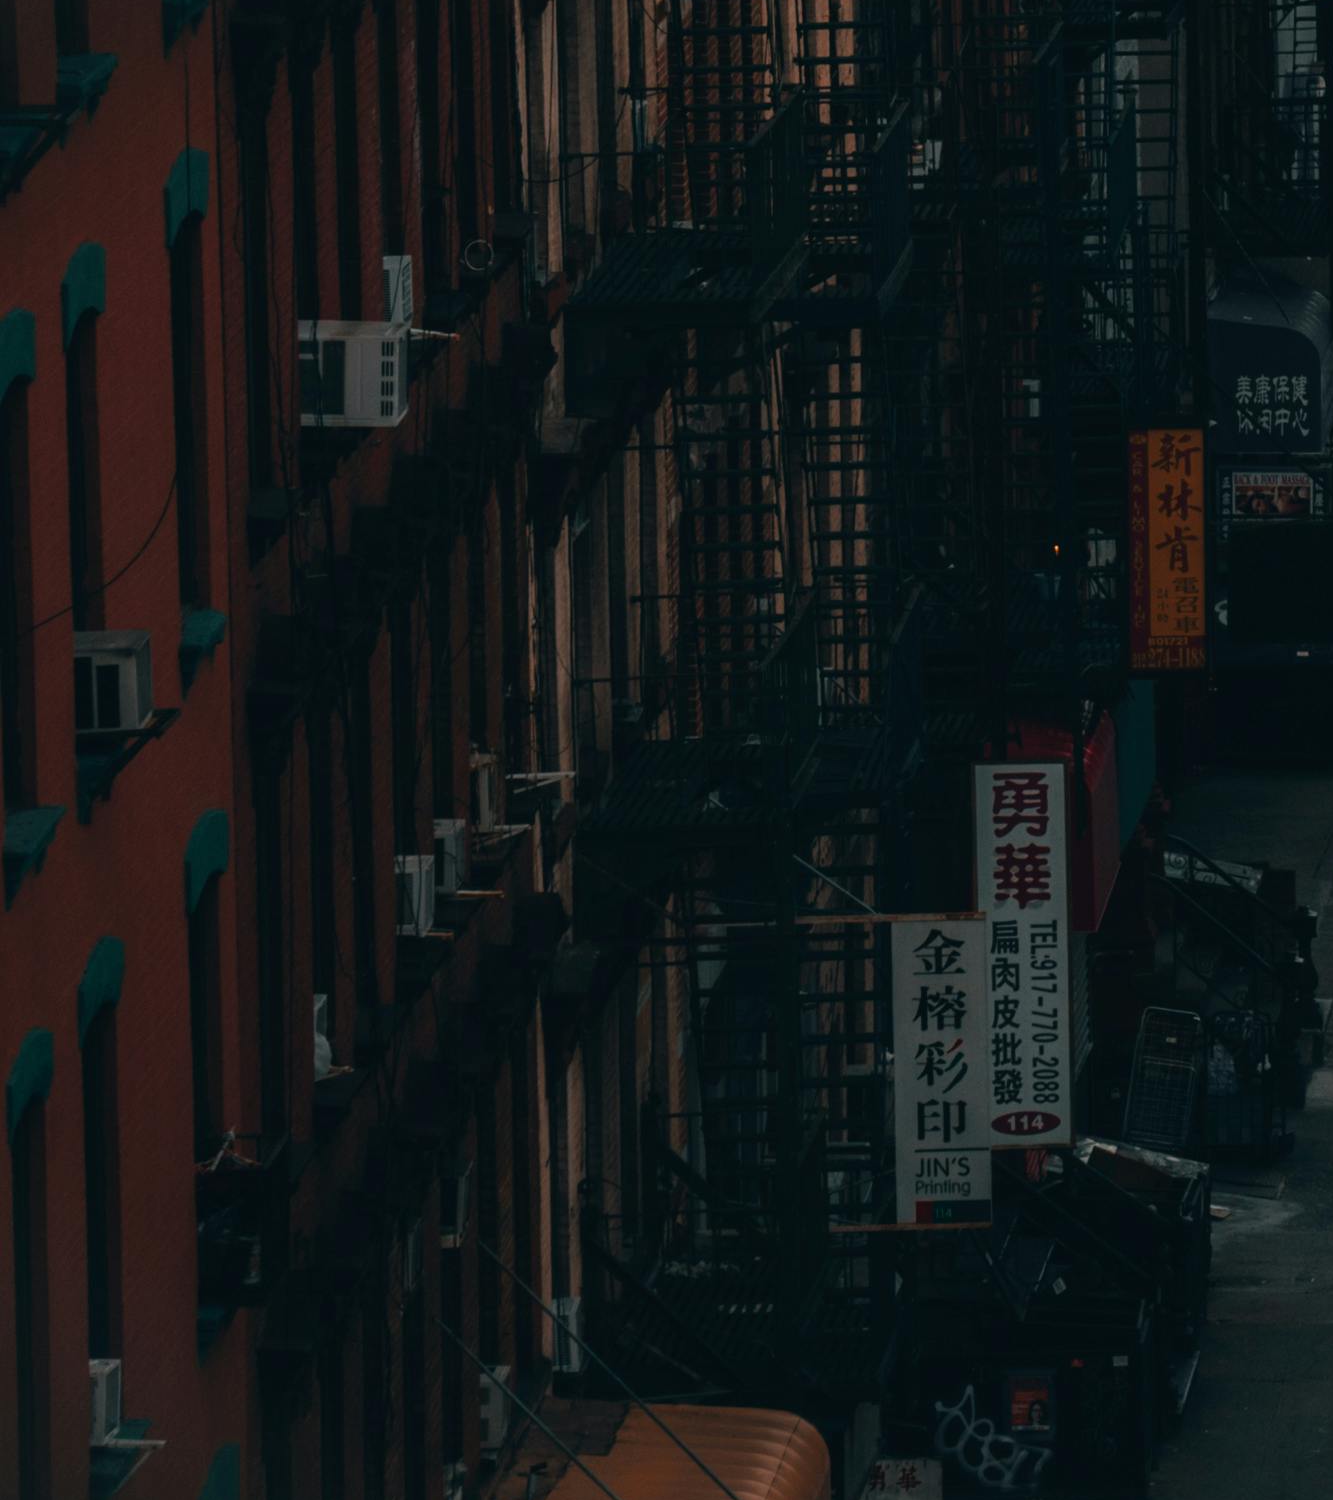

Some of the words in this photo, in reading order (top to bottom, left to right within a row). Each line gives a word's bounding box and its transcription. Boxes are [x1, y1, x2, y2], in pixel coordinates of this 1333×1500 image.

[992, 772, 1052, 909] 勇華
[912, 928, 968, 1144] 金榕彩印
[990, 919, 1024, 1106] 扁肉皮批發
[915, 1179, 971, 1197] Printing
[1006, 1113, 1043, 1131] 114
